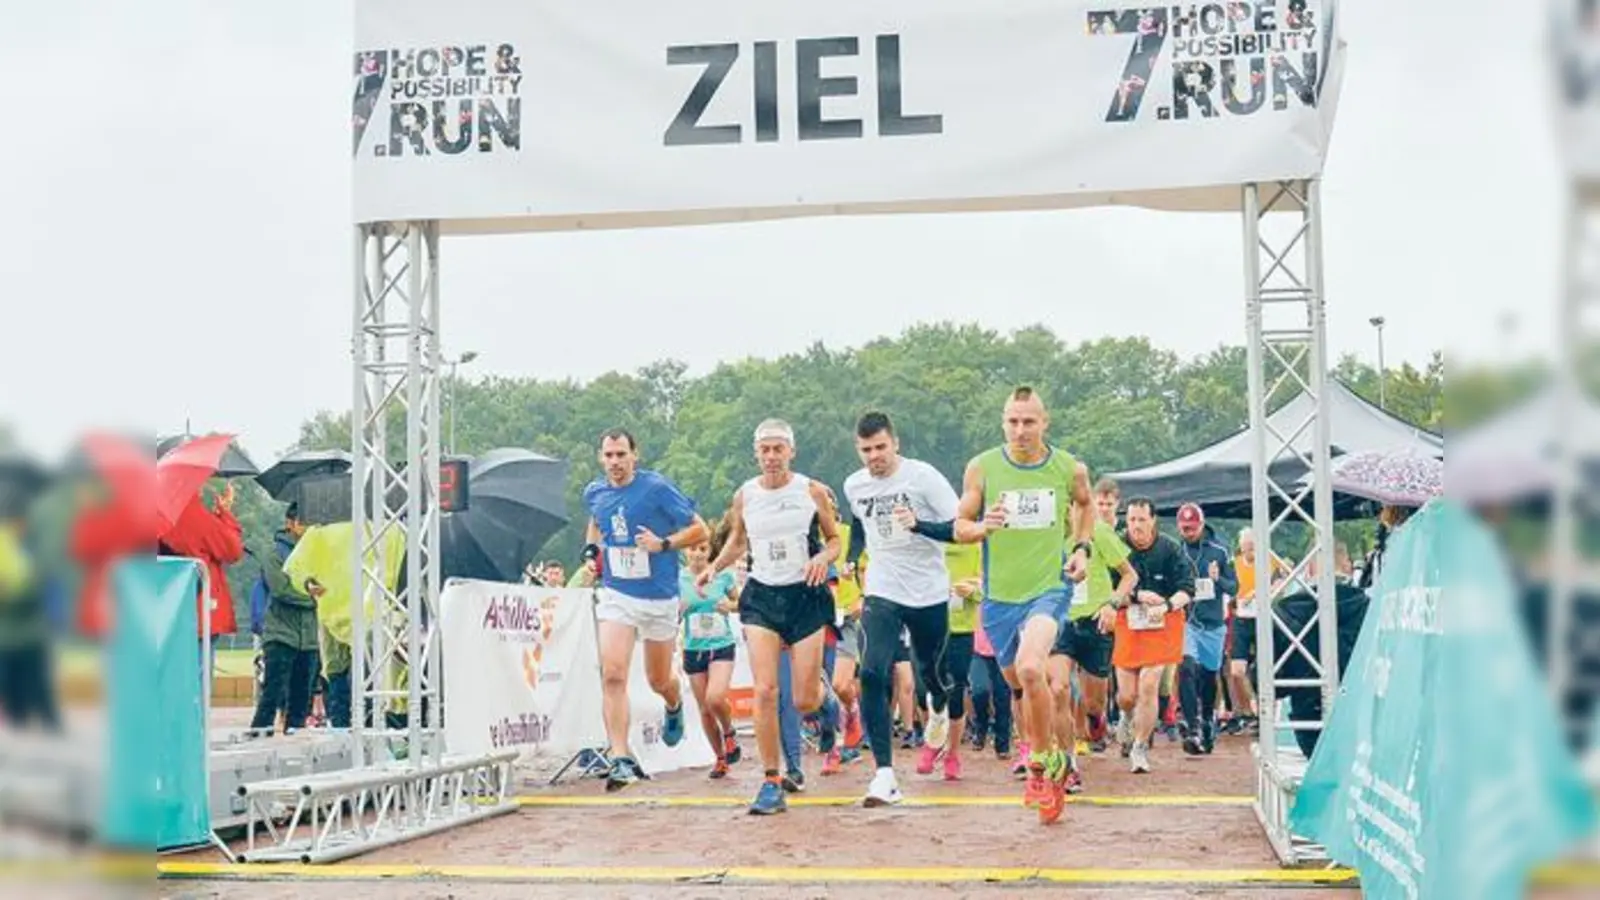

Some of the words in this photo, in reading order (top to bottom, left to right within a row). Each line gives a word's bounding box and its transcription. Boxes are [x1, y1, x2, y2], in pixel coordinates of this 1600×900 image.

[1171, 0, 1277, 37] HOPE
[391, 45, 486, 78] HOPE
[494, 43, 523, 74] &
[1171, 29, 1317, 58] POSSIBILITY
[390, 75, 522, 99] POSSIBILITY
[663, 34, 943, 146] ZIEL
[482, 594, 540, 630] Achilles
